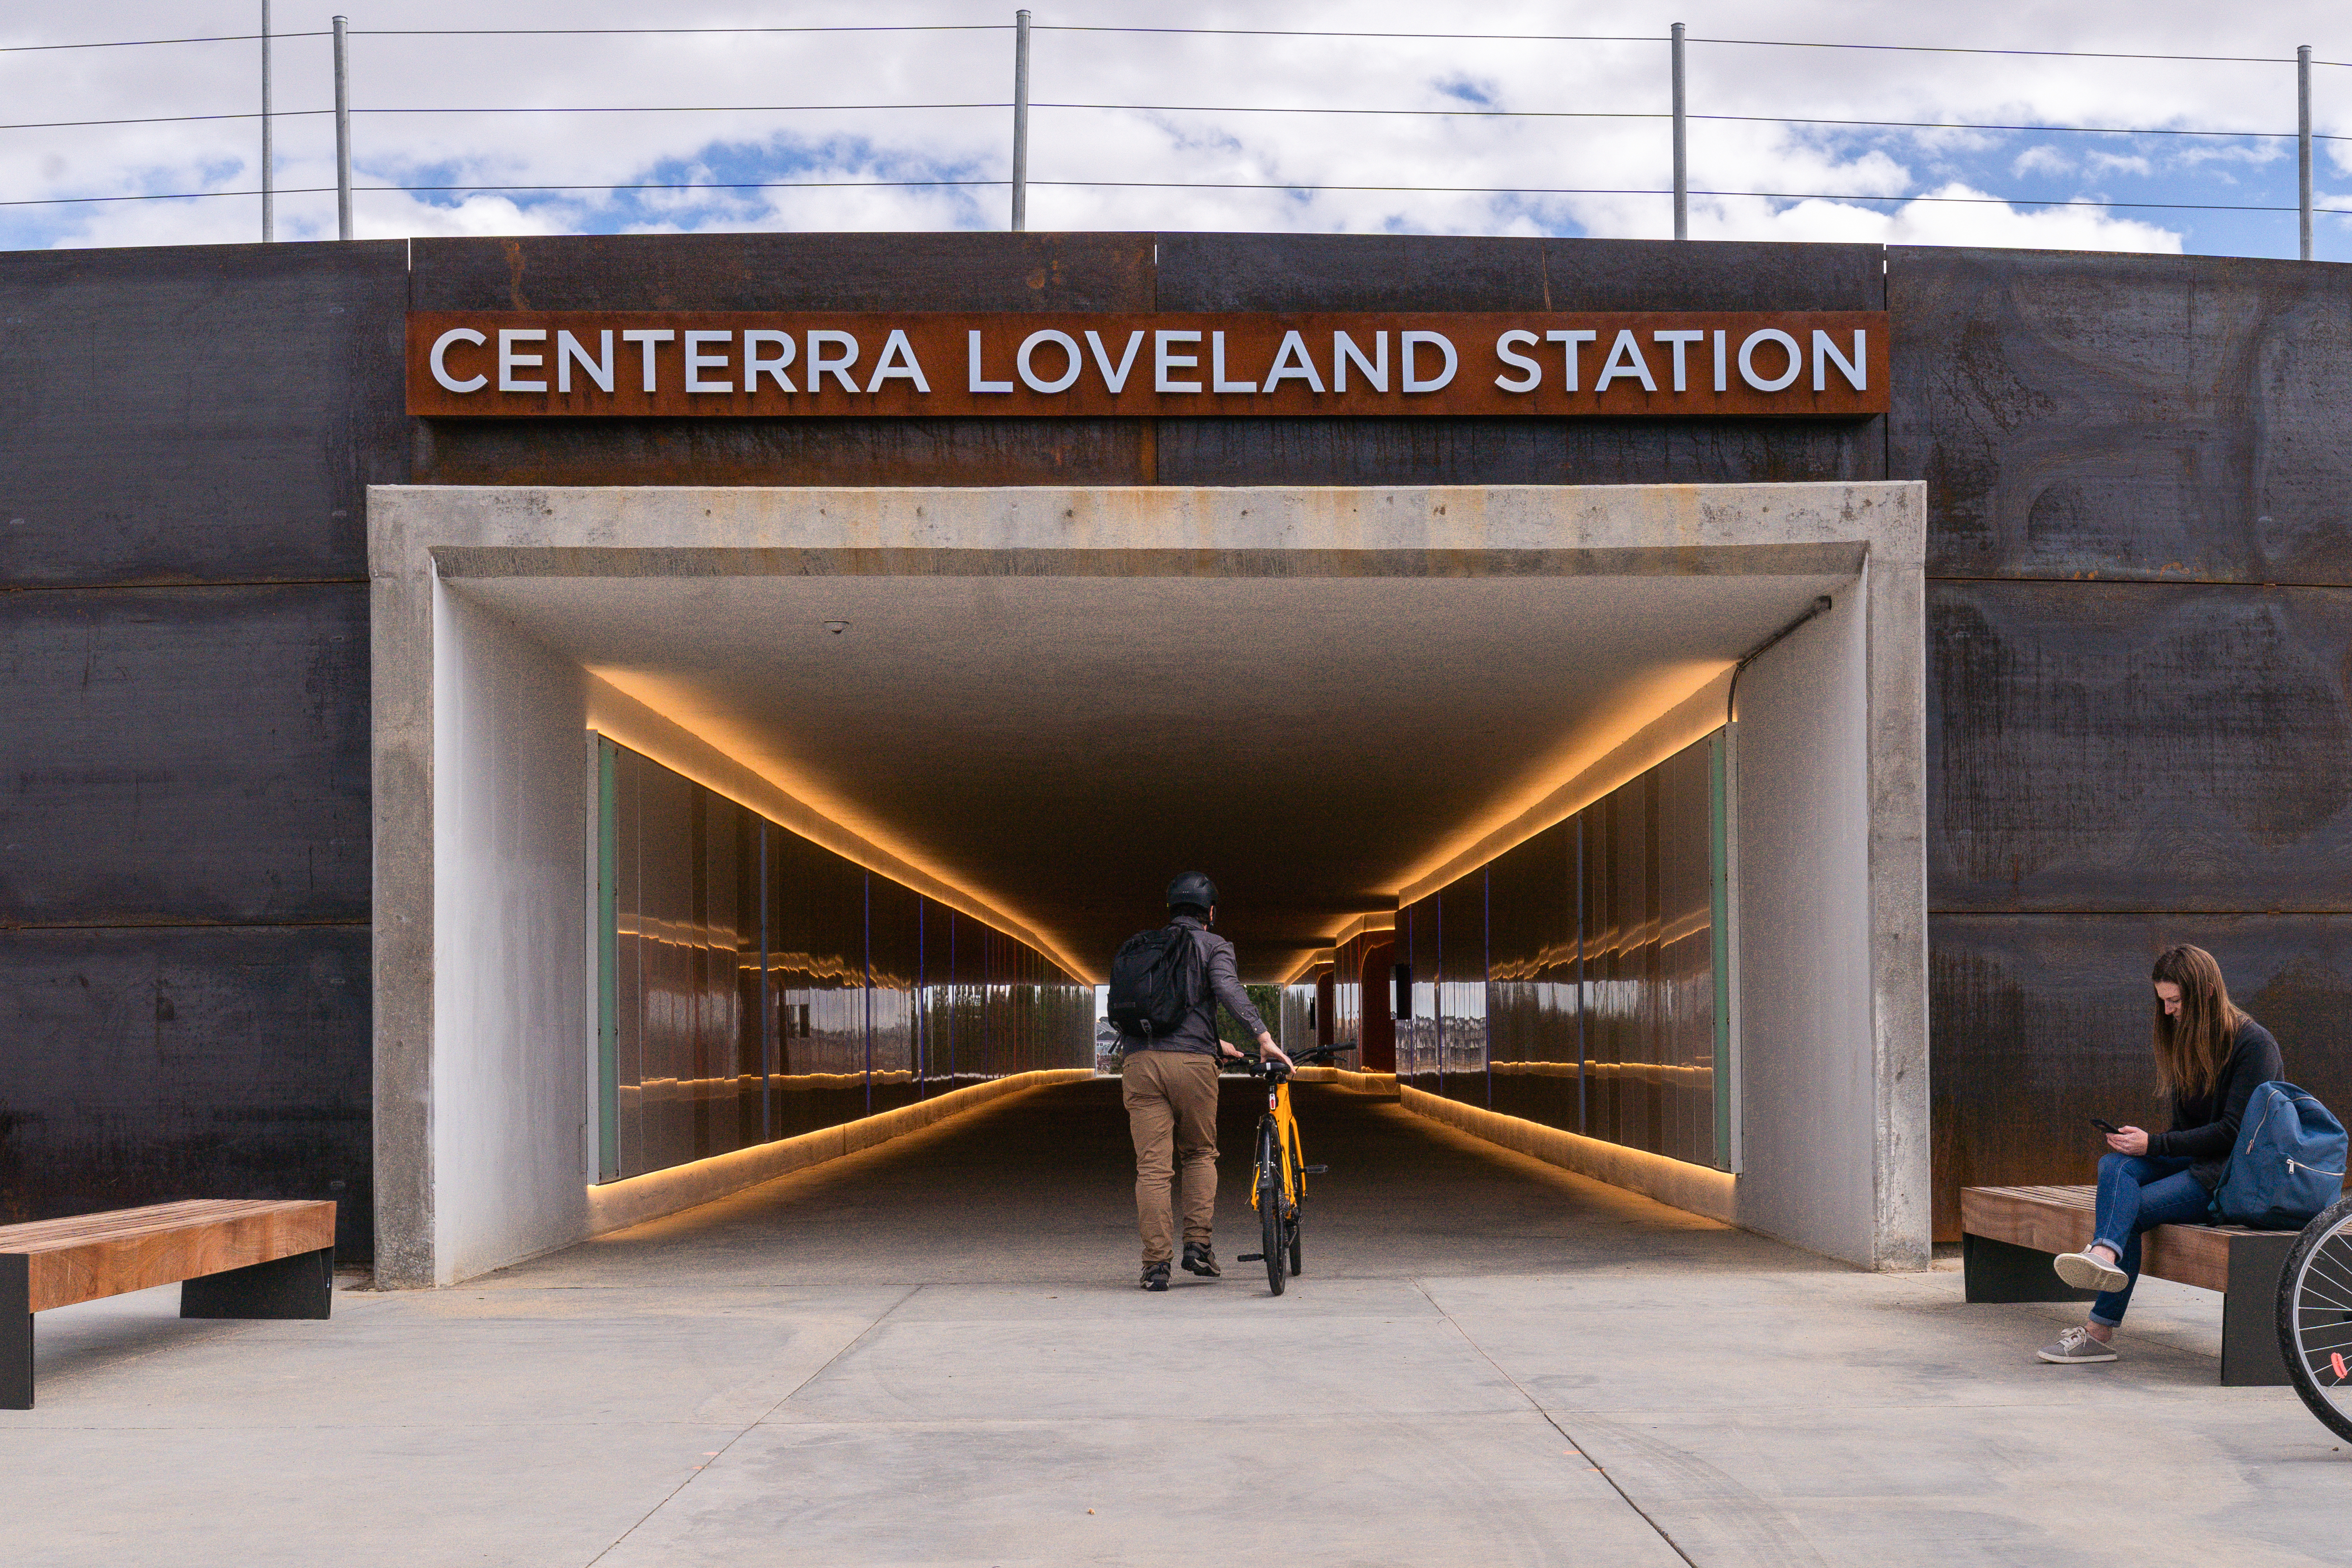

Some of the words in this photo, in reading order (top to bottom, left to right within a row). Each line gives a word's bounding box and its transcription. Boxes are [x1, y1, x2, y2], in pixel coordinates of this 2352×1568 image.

[430, 328, 931, 393] CENTERRA
[968, 329, 1458, 393] LOVELAND
[1494, 329, 1866, 392] STATION
